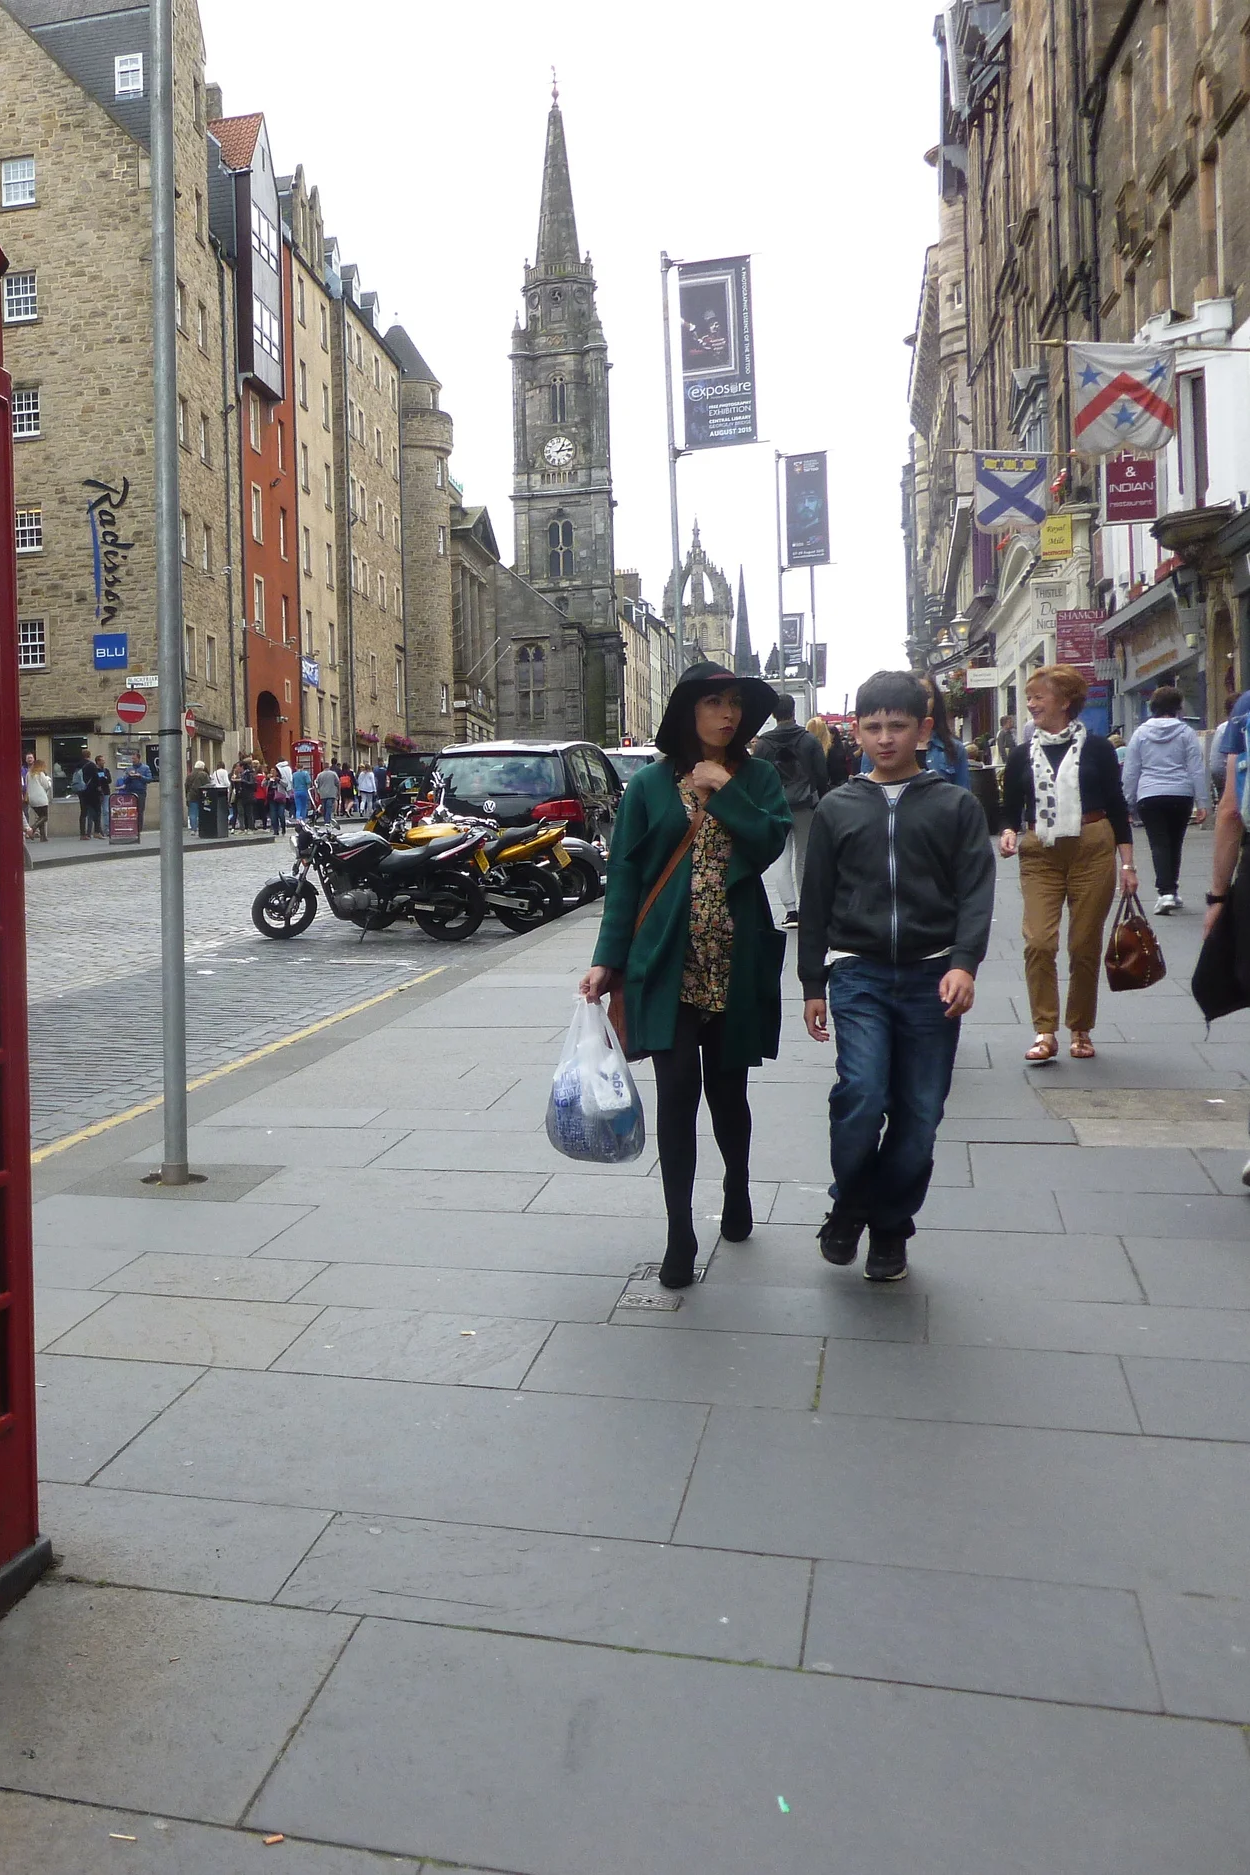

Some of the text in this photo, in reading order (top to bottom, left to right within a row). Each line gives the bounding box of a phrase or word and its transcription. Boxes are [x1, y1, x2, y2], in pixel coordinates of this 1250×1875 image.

[708, 405, 751, 416] EXHIBITION
[709, 426, 752, 437] AUGUST 2015
[1125, 466, 1137, 477] &
[1109, 482, 1154, 493] INDIAN
[1046, 524, 1066, 534] Royal
[1048, 536, 1066, 545] Mile
[82, 476, 135, 626] Radisson
[1034, 587, 1063, 599] THISTLE
[1040, 601, 1057, 615] Do
[1058, 610, 1104, 621] SHAMOLI
[96, 647, 125, 658] BLU
